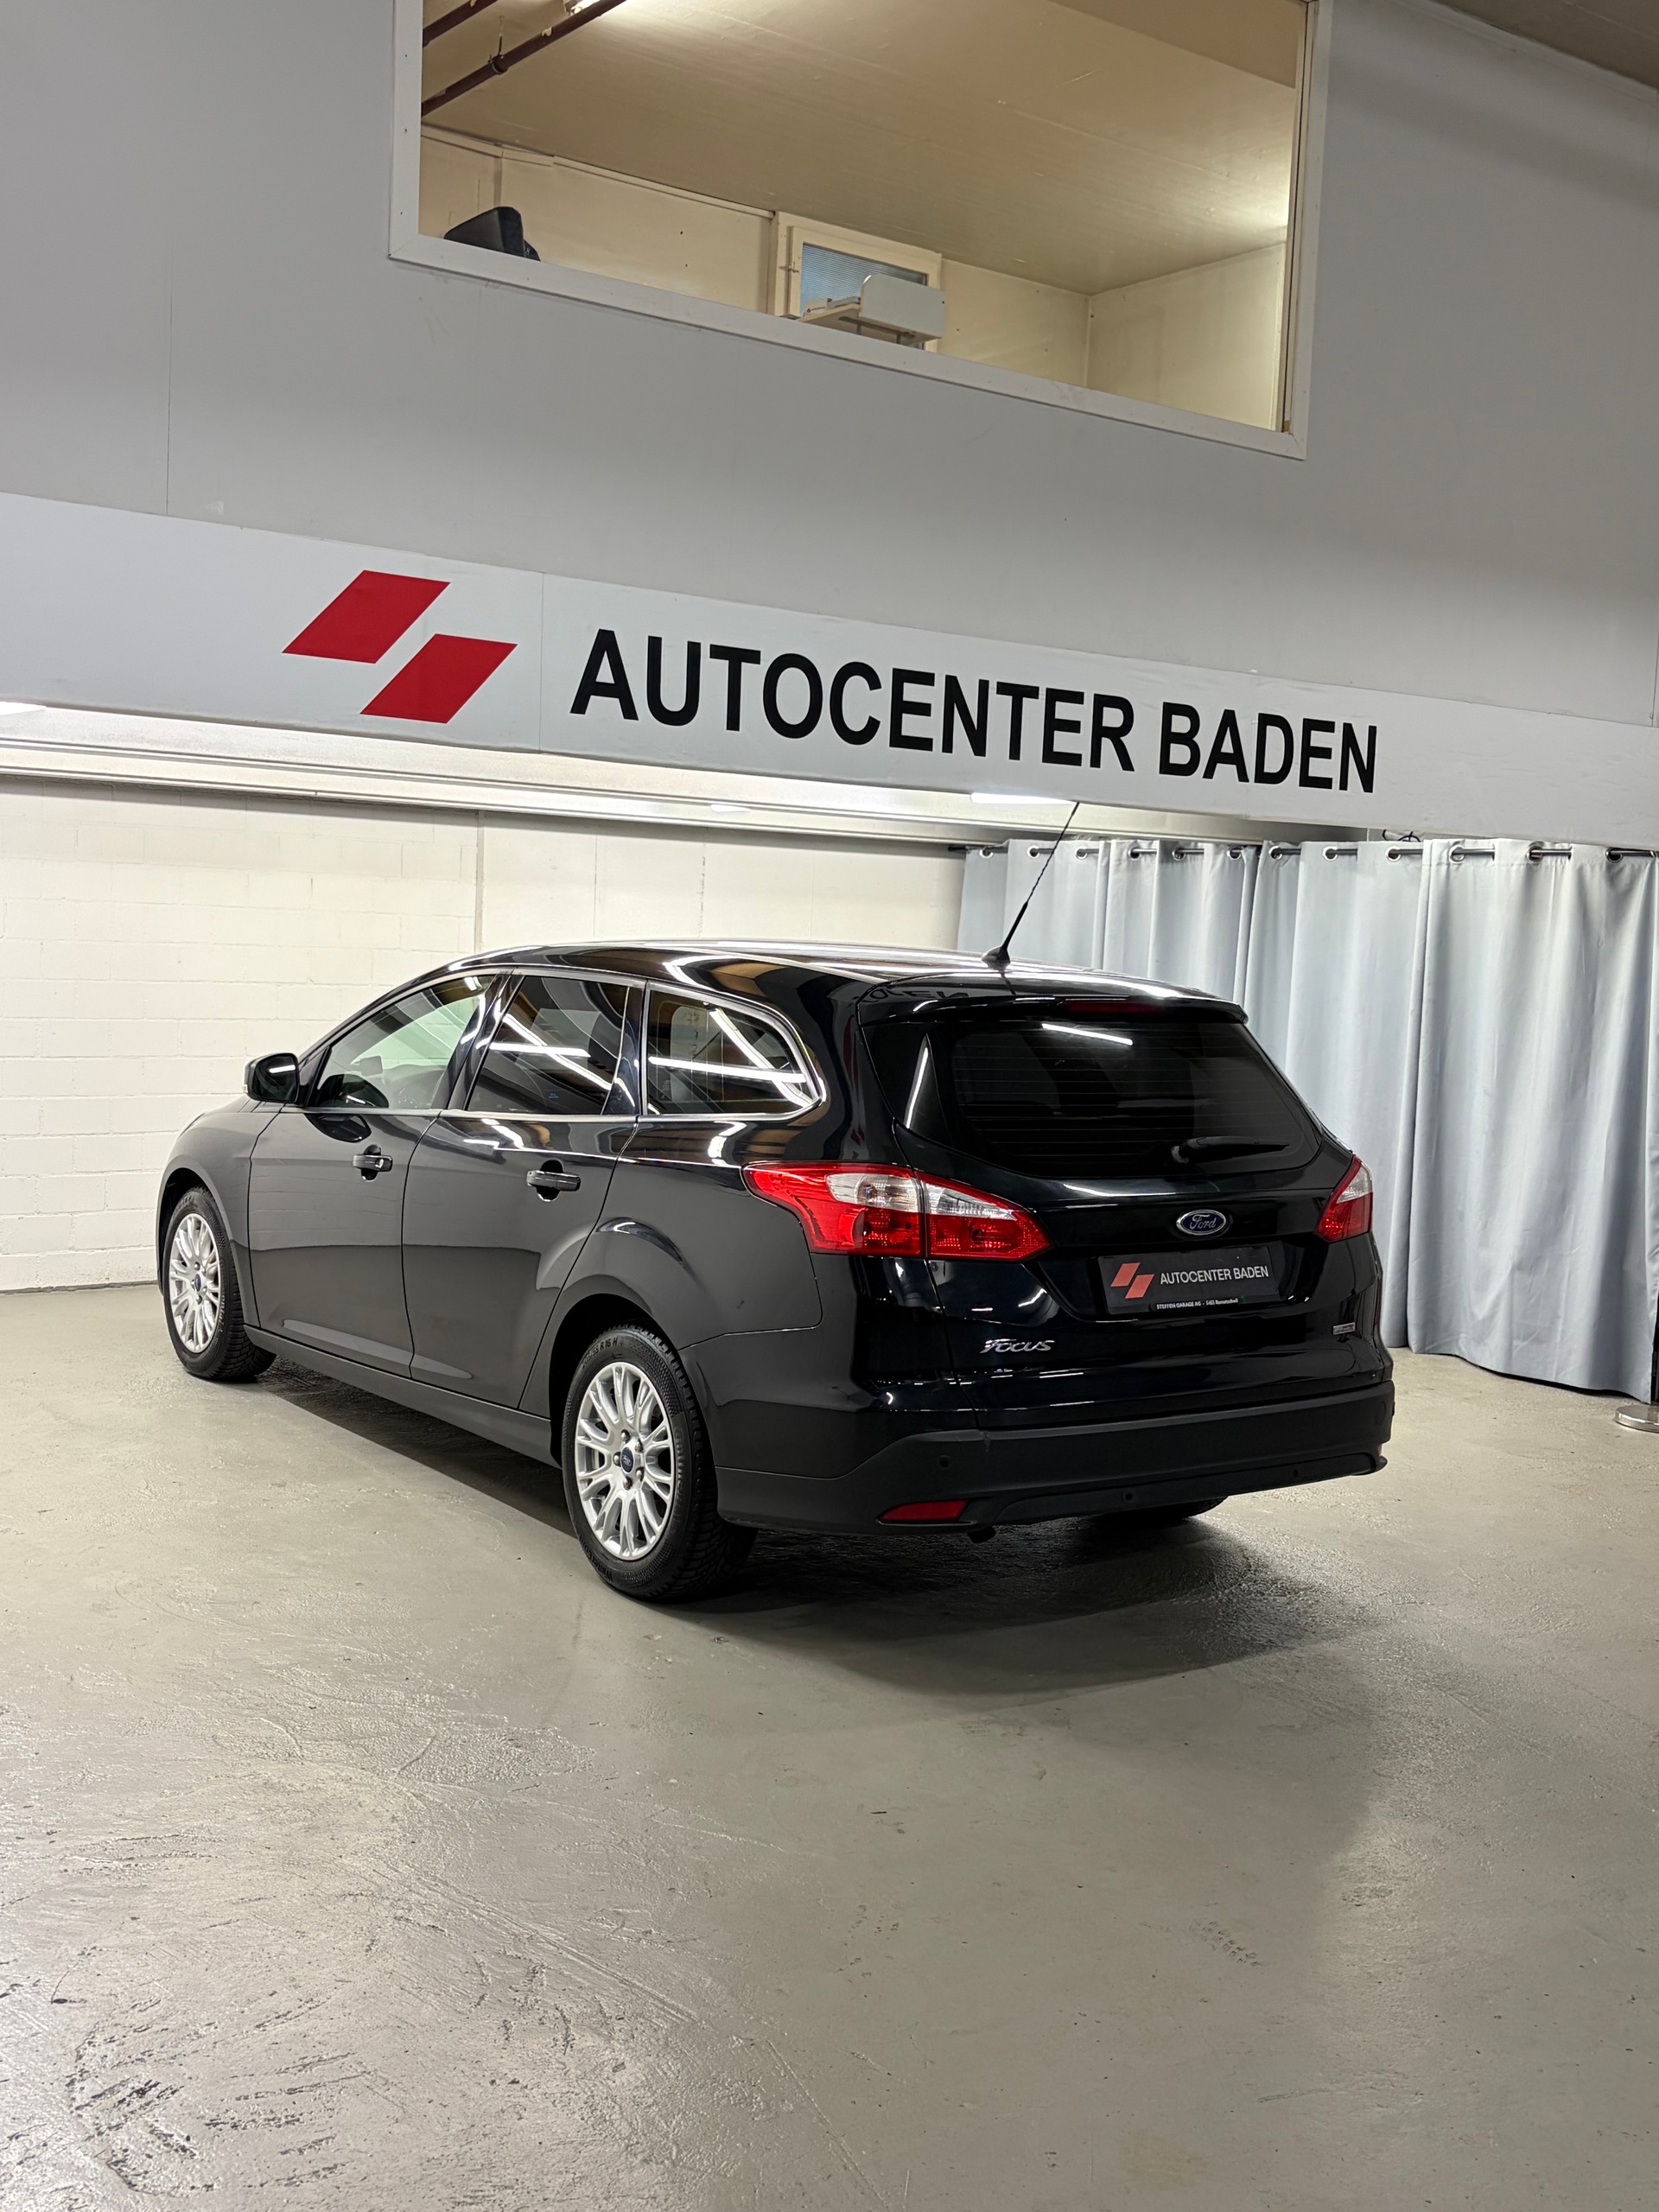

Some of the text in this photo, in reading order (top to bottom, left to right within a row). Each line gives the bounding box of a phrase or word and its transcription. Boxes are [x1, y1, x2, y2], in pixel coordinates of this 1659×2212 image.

[571, 628, 1378, 793] AUTOCENTER BADEN
[1189, 1213, 1217, 1230] Ford
[1160, 1265, 1269, 1286] AUTOCENTER BADEN
